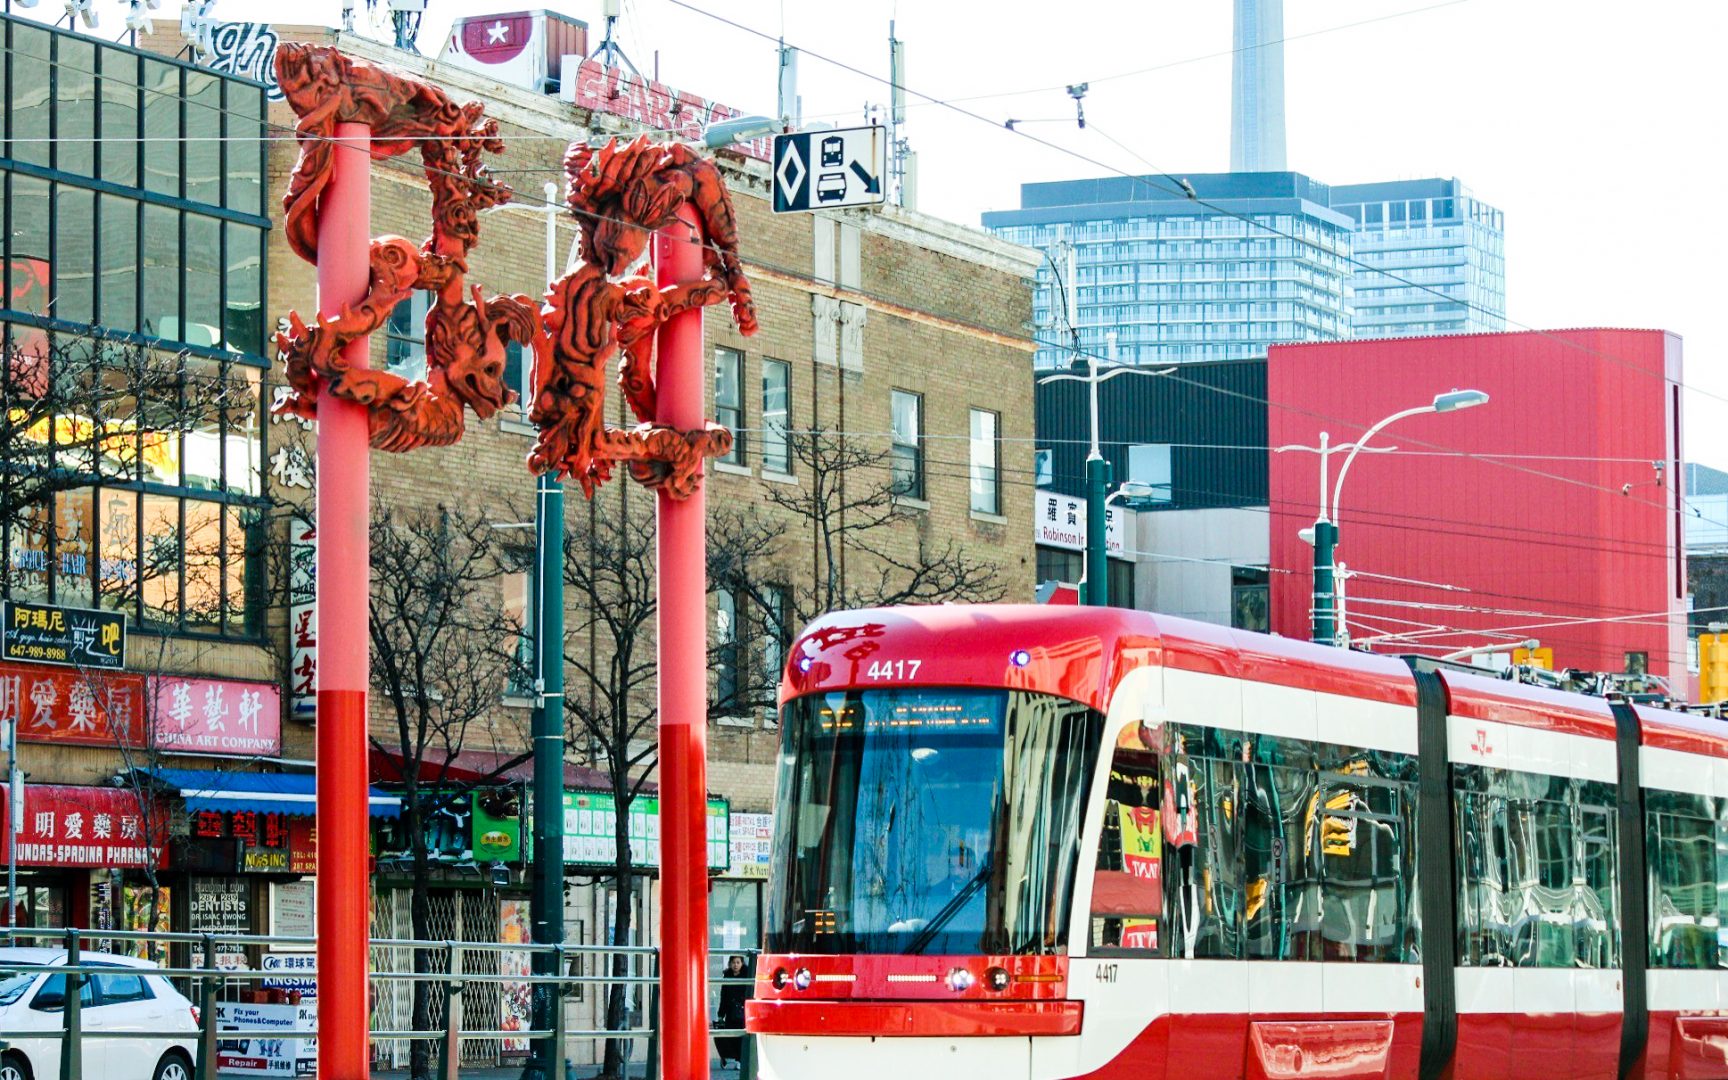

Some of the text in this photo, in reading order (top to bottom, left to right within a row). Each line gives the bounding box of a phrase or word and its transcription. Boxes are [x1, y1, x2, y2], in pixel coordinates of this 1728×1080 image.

[1043, 526, 1077, 544] Robinson
[14, 607, 66, 632] 阿瑪尼
[10, 645, 67, 660] 647-989-8988
[867, 660, 922, 680] 4417
[156, 732, 275, 750] CHINA ART COMPANY
[15, 843, 103, 863] UNDAS-SPADINA
[191, 901, 246, 911] DENTISTS
[1095, 964, 1118, 983] 4417
[245, 1009, 259, 1018] your
[228, 1058, 258, 1068] Repair
